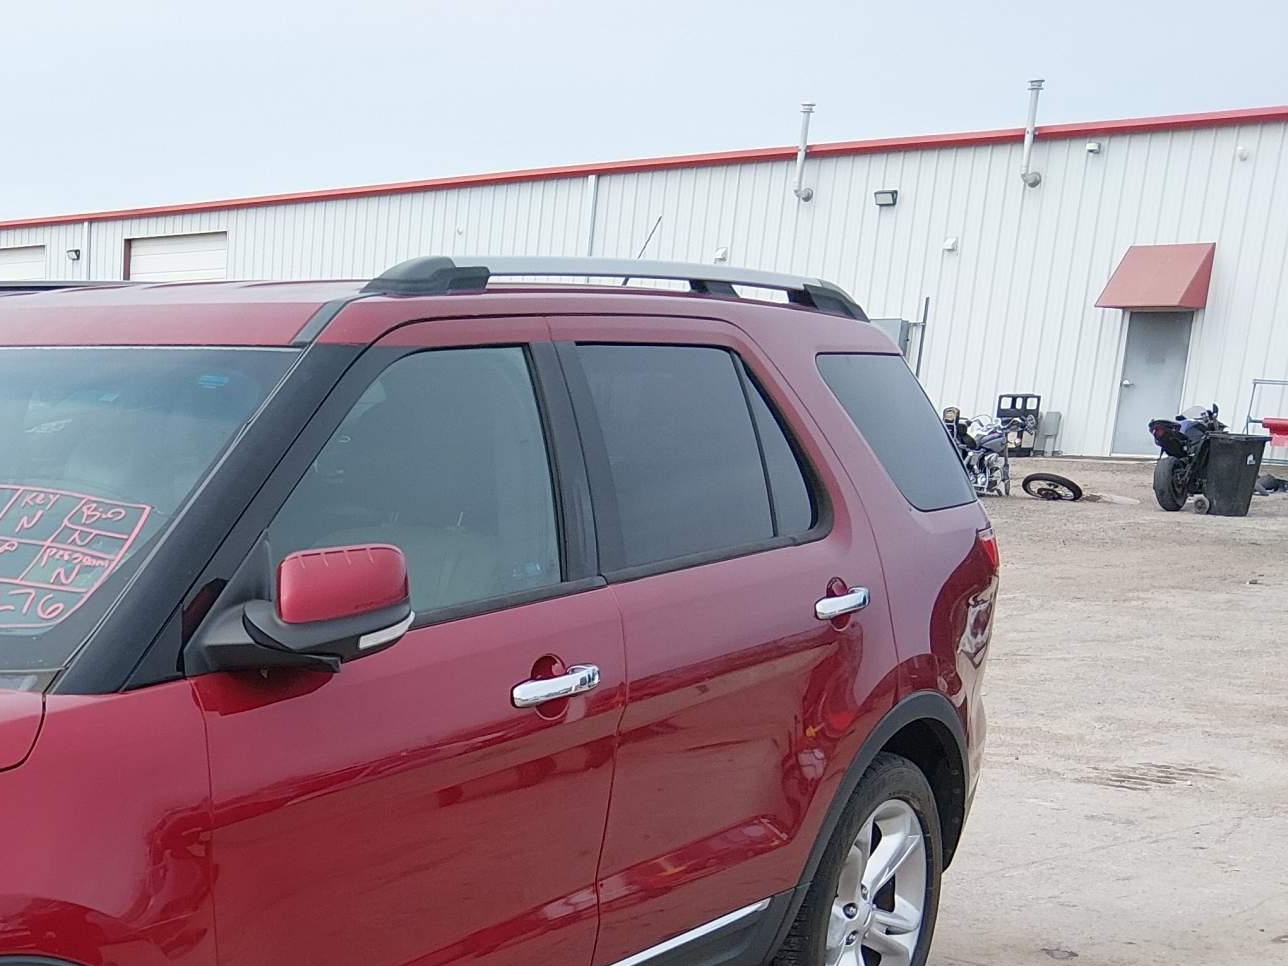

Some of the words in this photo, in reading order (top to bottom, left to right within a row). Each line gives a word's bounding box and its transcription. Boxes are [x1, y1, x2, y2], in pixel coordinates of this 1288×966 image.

[14, 509, 45, 533] N
[67, 529, 96, 546] N
[49, 563, 82, 585] N
